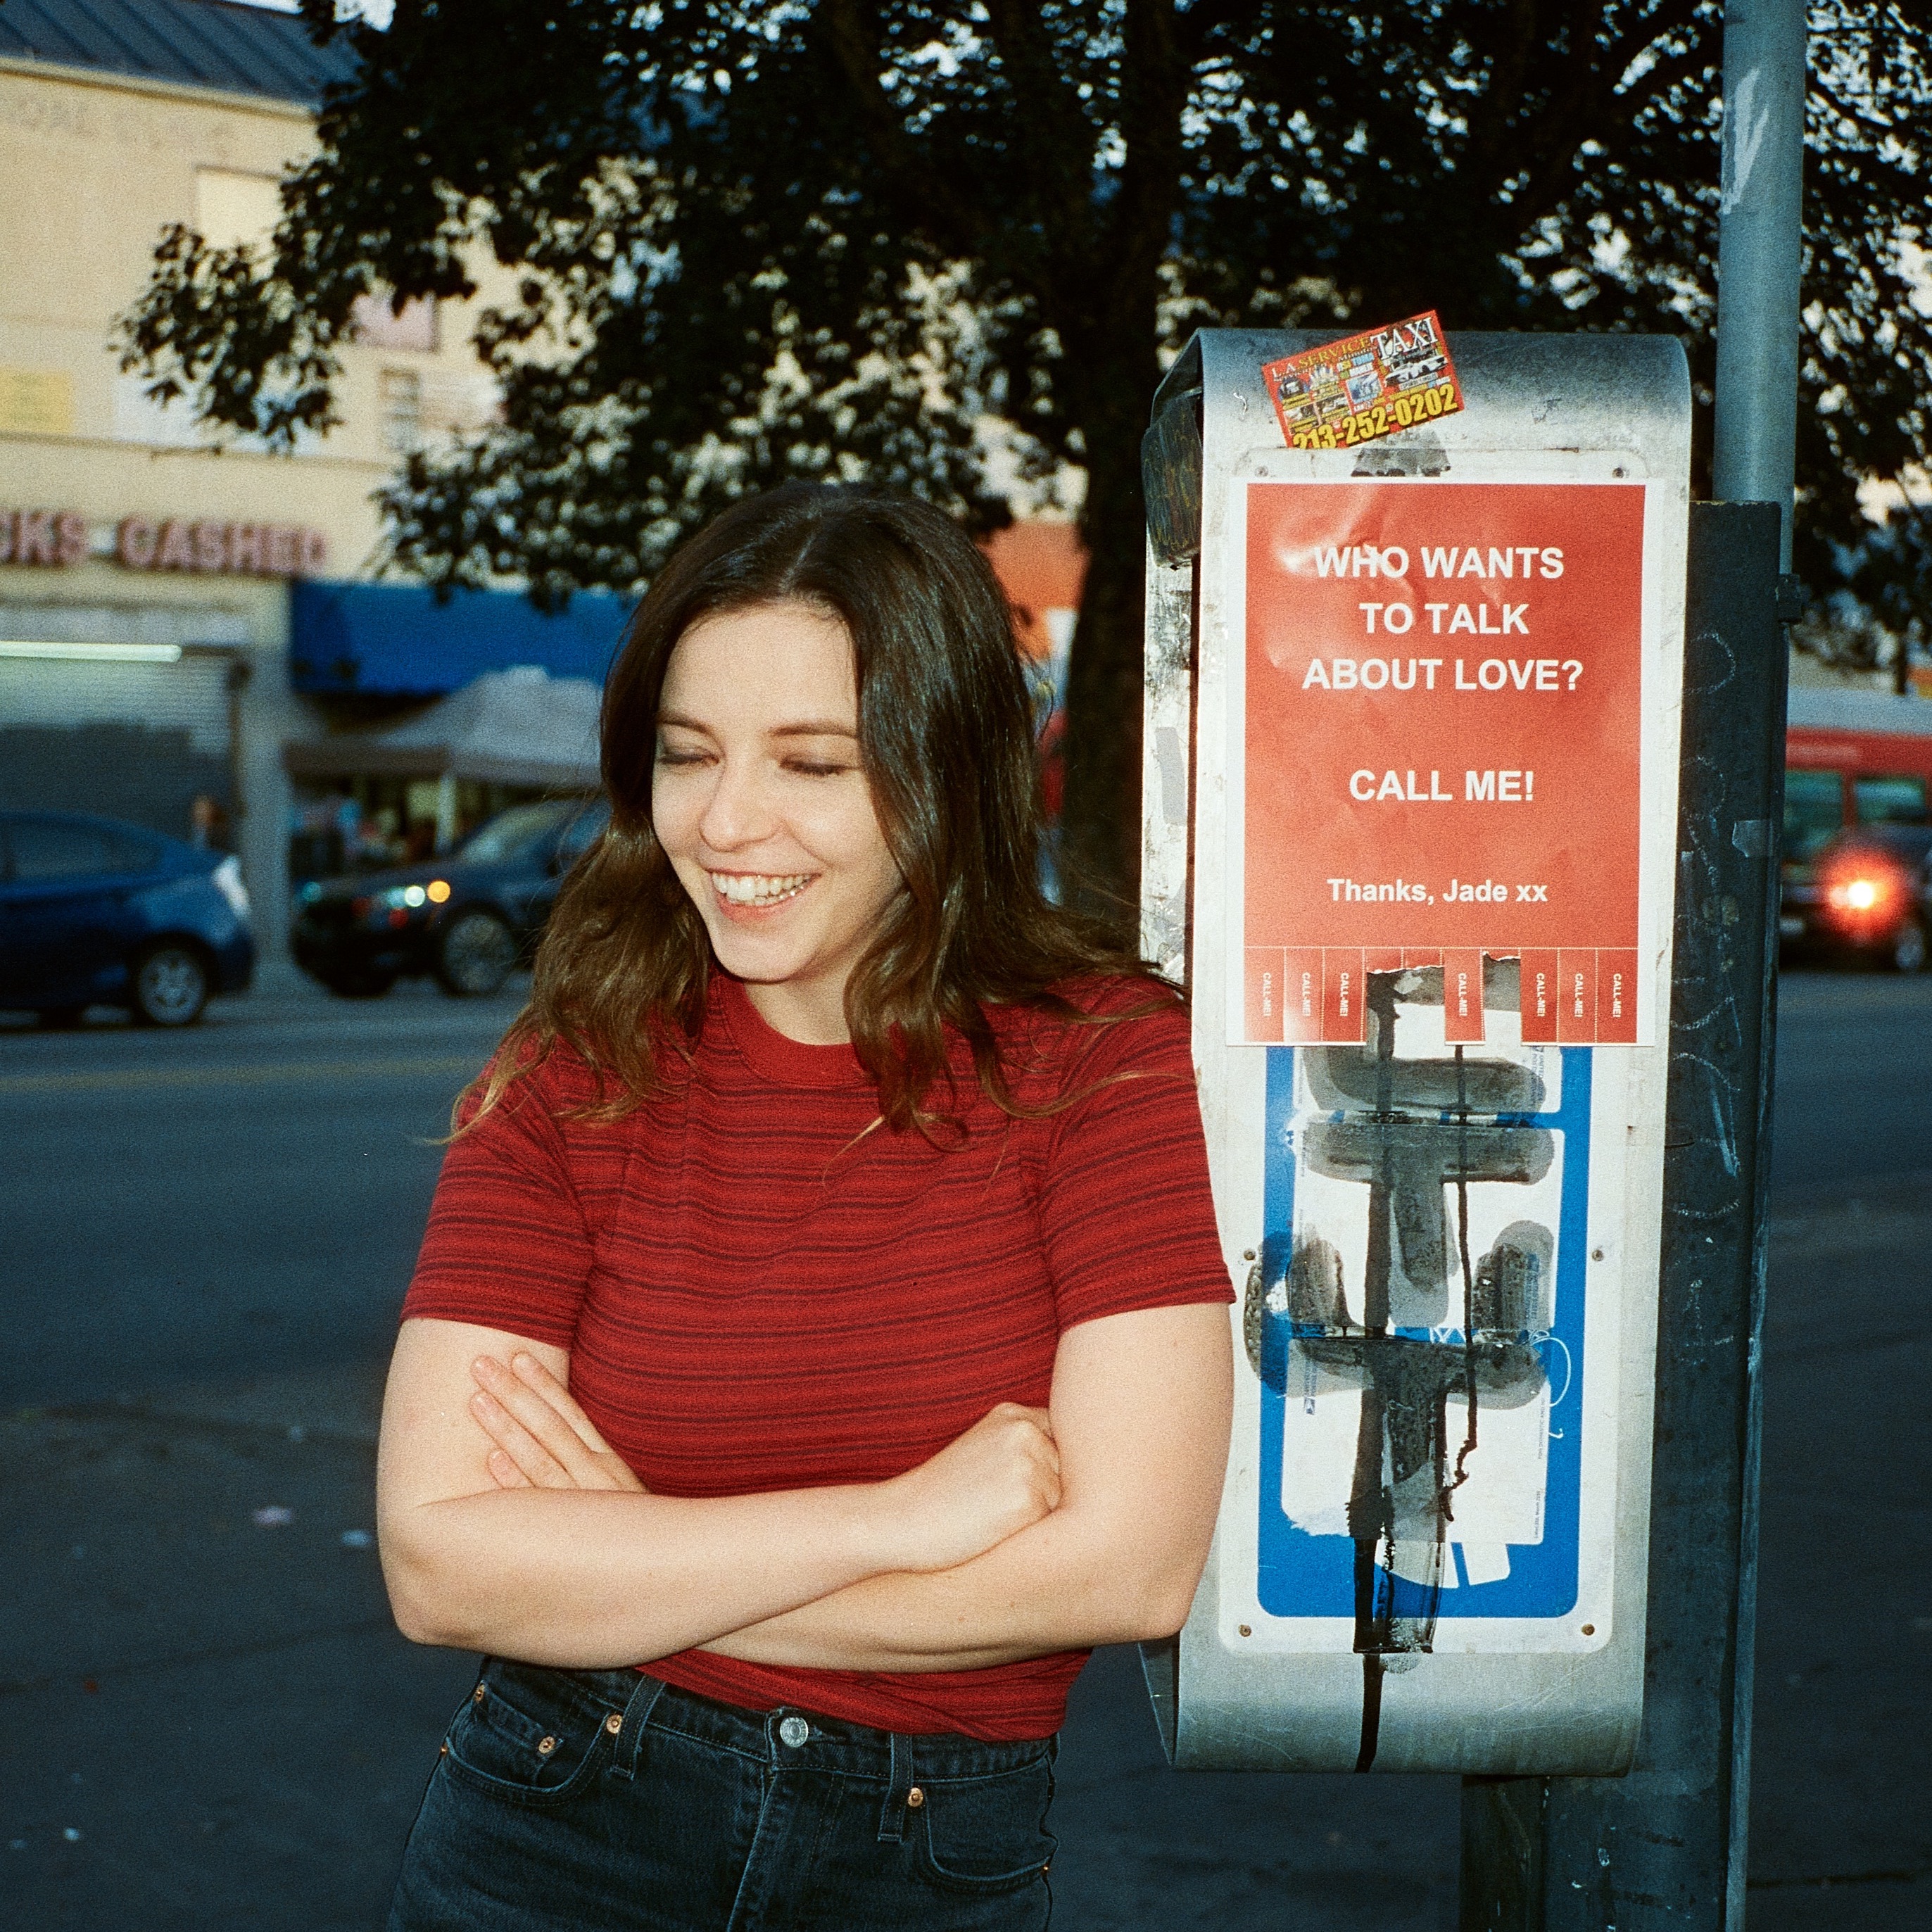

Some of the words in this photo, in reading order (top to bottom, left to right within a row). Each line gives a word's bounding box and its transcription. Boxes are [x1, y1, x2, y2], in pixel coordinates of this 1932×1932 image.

[1298, 336, 1372, 367] SERVICE
[1370, 317, 1438, 360] TAXI
[115, 515, 327, 572] CASHED
[1314, 547, 1409, 579] WHO
[1420, 547, 1564, 579] WANTS
[1358, 602, 1414, 634] TO
[1425, 603, 1529, 634] TALK
[1302, 659, 1442, 690] ABOUT
[1455, 659, 1584, 690] LOVE?
[1349, 769, 1452, 801] CALL
[1465, 770, 1534, 801] ME!
[1327, 878, 1434, 905] Thanks,
[1442, 878, 1508, 902] Jade
[1516, 885, 1548, 902] xx
